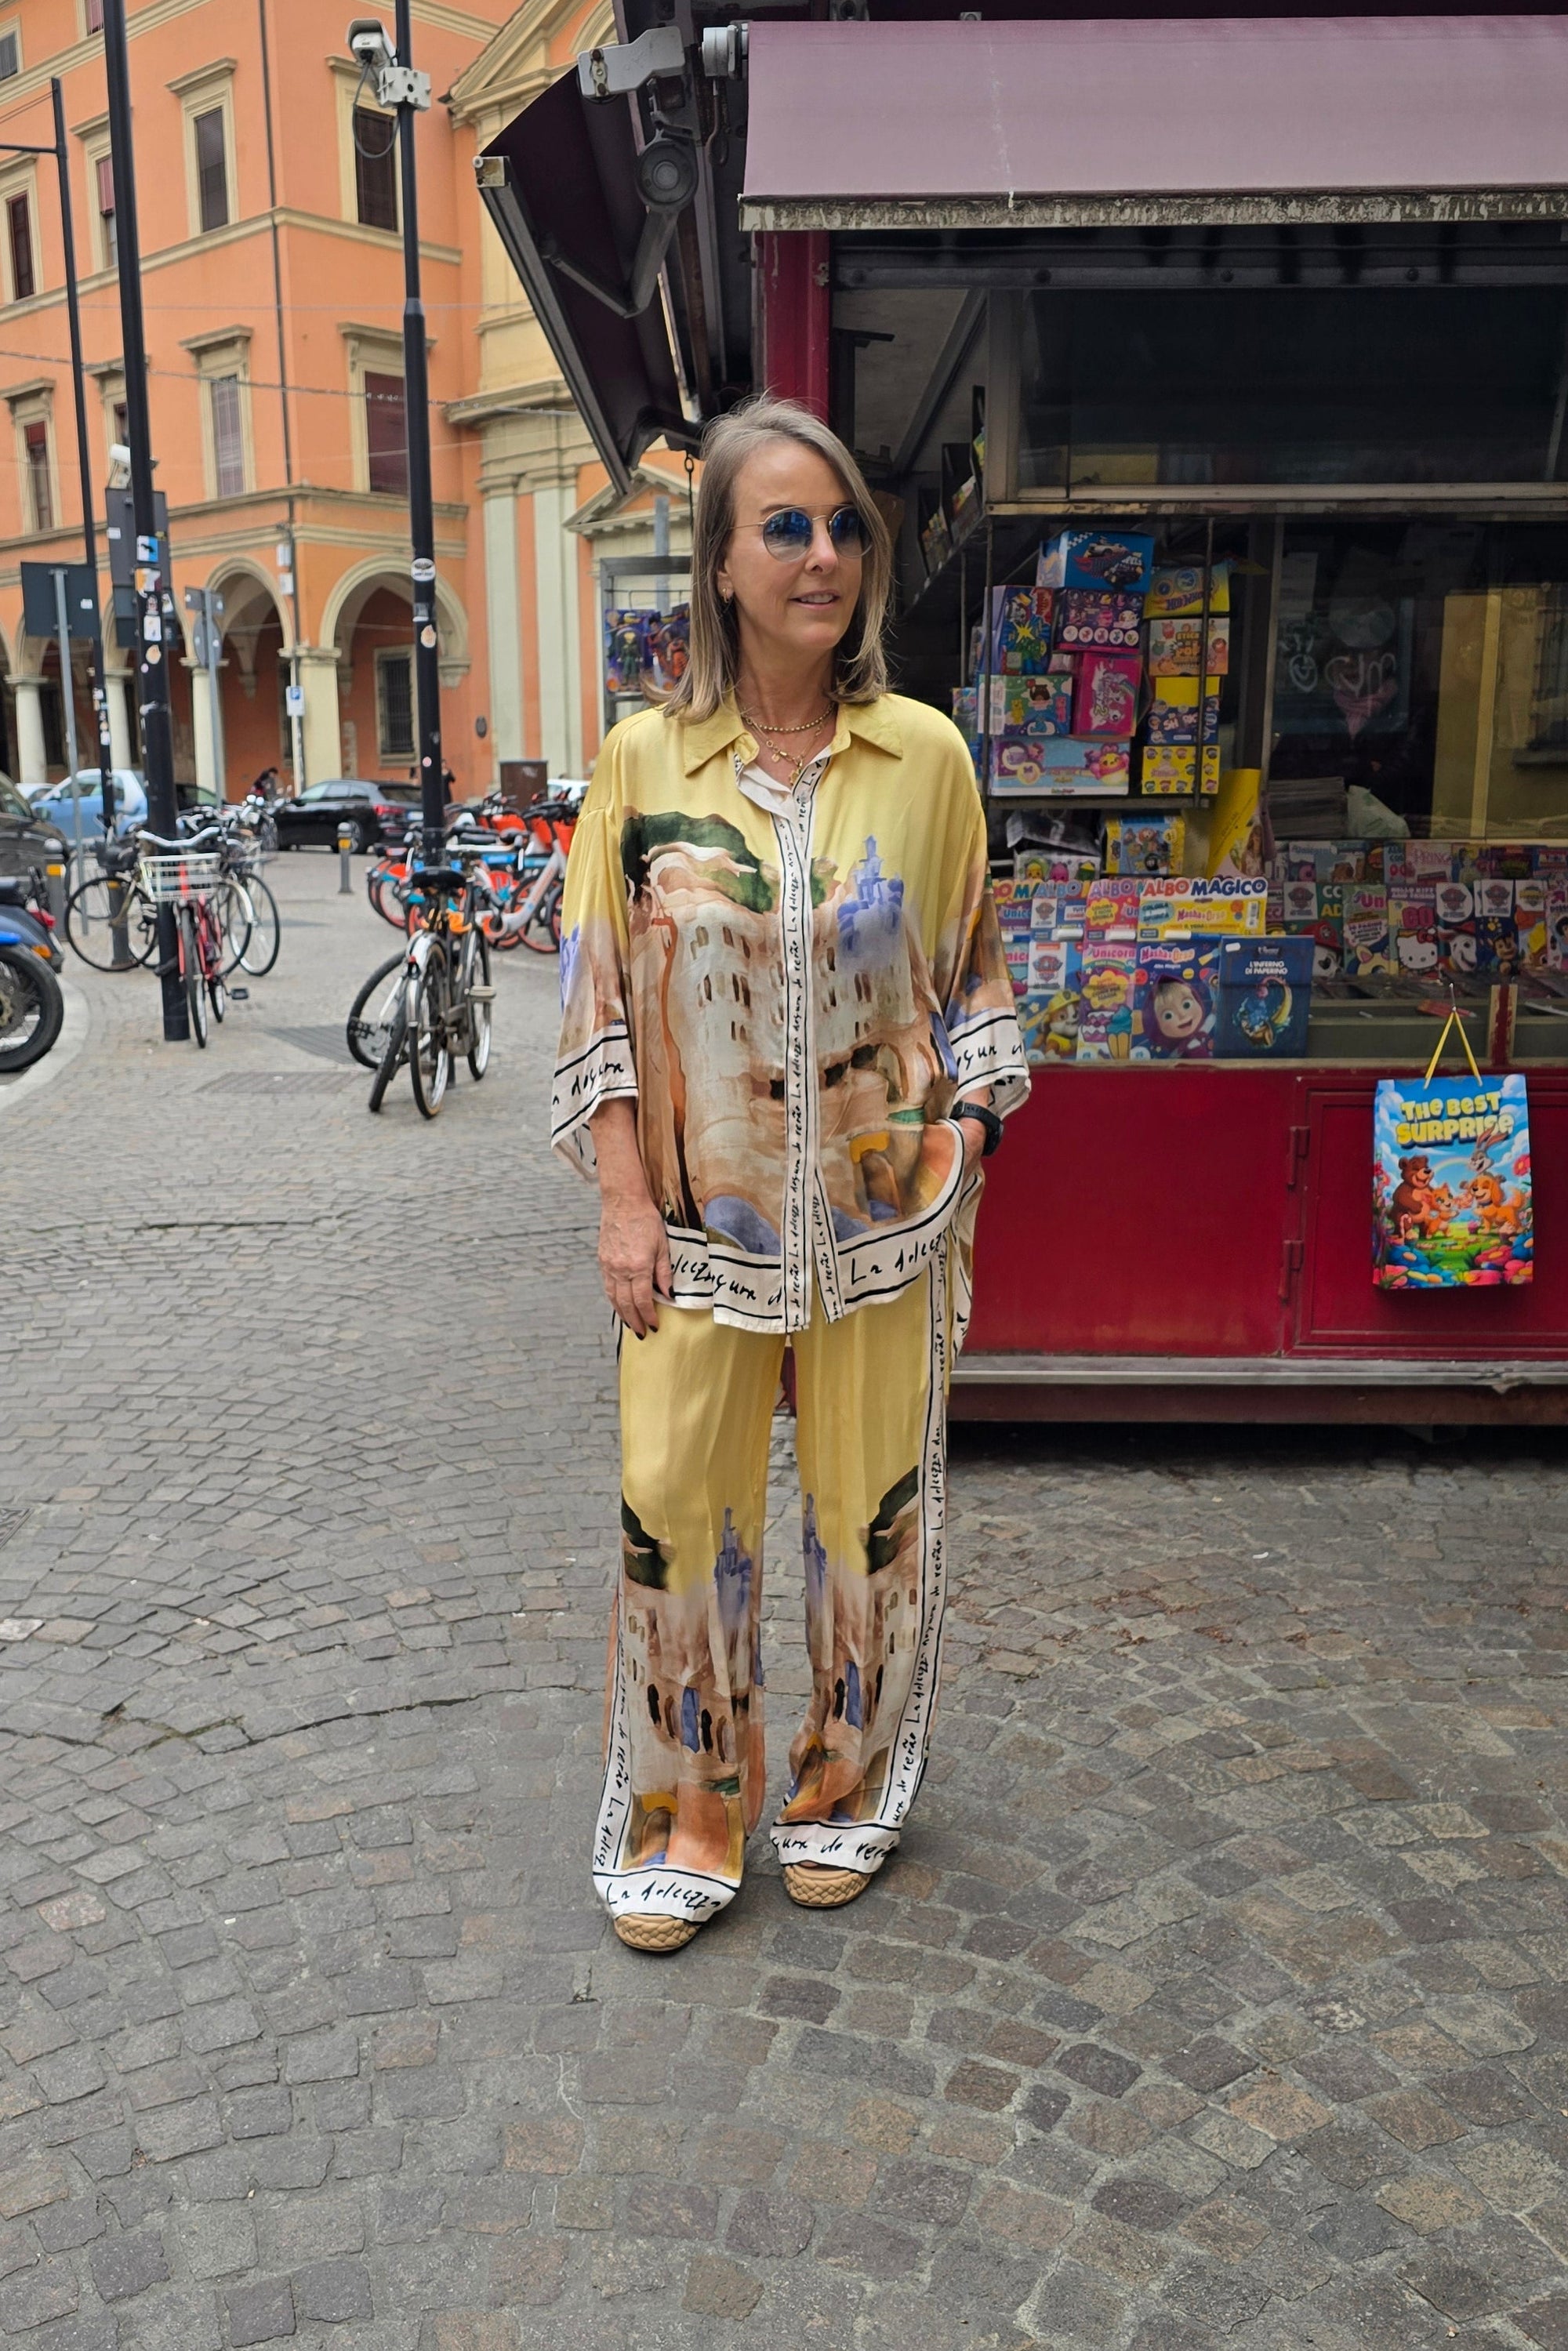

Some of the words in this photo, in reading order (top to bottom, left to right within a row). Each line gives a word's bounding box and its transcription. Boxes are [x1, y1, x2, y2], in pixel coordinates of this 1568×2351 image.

[1035, 880, 1082, 898] ALBO
[1091, 879, 1134, 898] ALBO
[1143, 880, 1189, 897] ALBO
[1191, 879, 1267, 896] MAGICO
